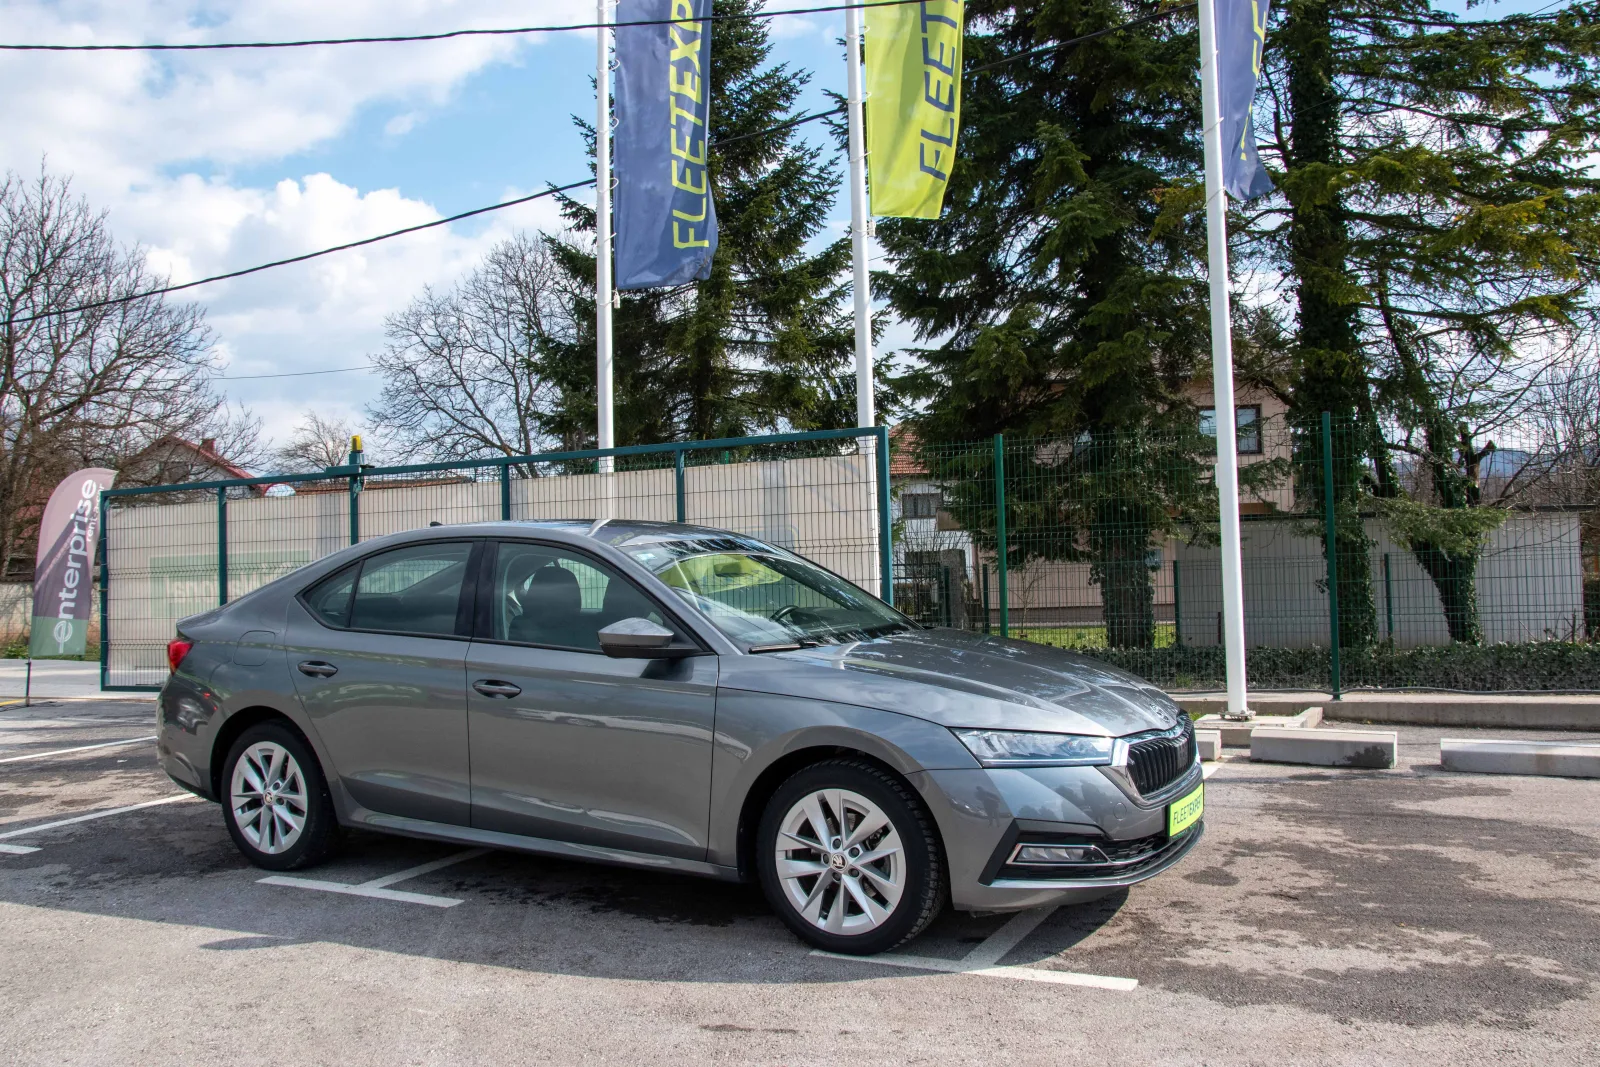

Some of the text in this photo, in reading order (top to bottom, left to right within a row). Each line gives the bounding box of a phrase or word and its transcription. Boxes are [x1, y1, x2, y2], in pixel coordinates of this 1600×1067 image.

[669, 0, 709, 249] FLEETEXP
[919, 0, 958, 182] FLEET
[53, 480, 97, 653] enterprise
